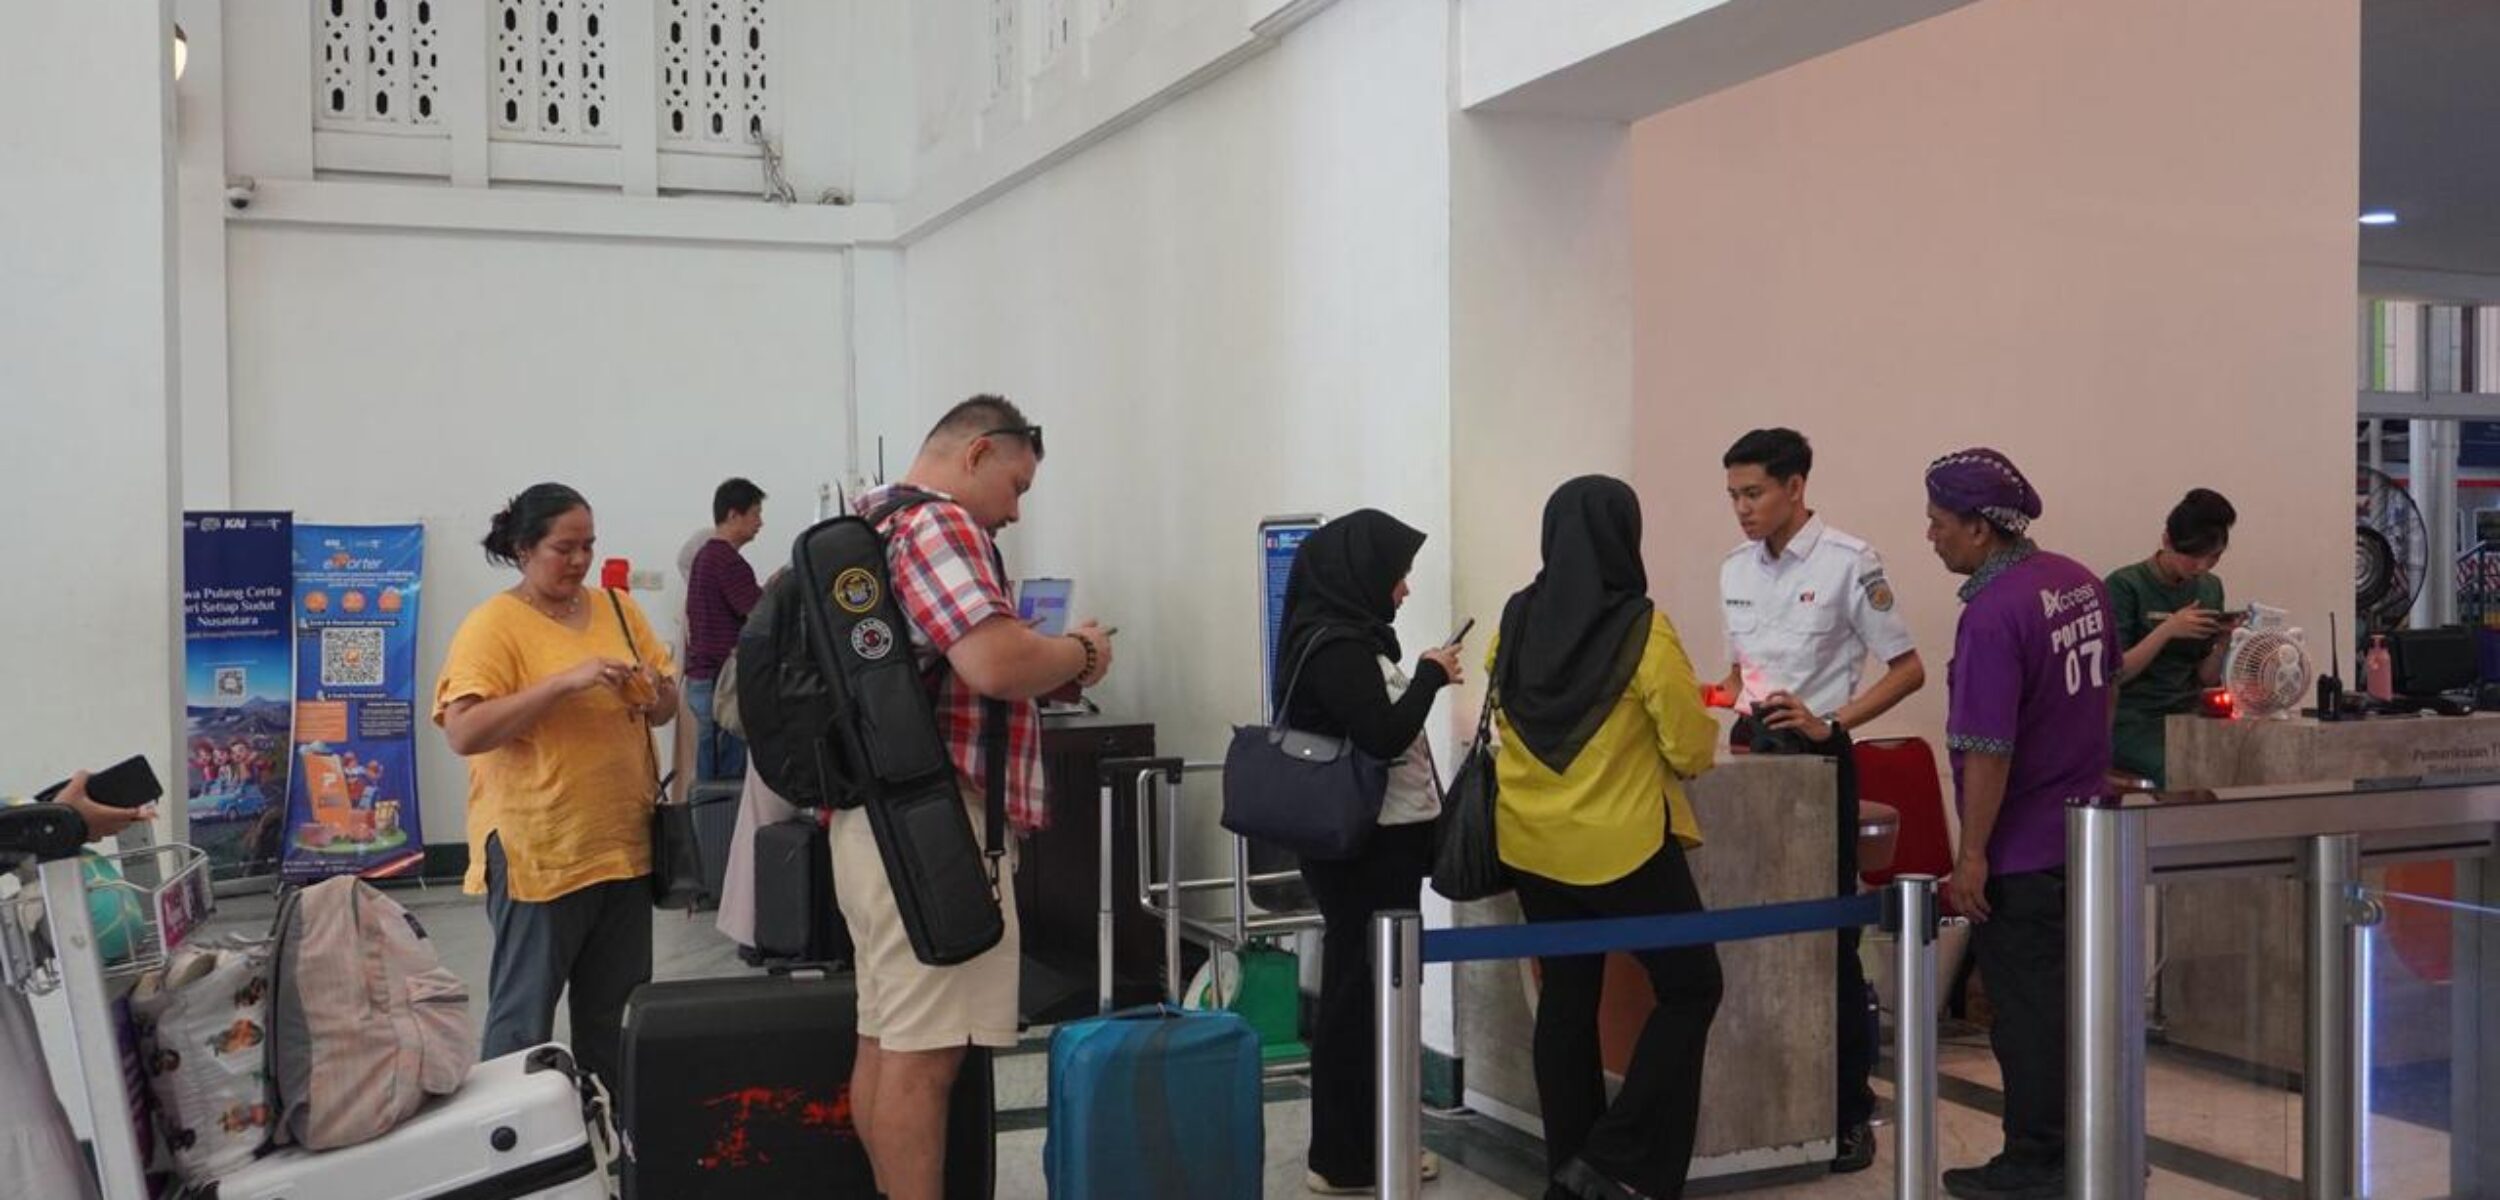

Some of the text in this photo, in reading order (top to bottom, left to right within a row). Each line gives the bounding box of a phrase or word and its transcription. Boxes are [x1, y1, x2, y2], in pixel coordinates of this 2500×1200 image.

[184, 586, 282, 601] wa Pulang Cerita
[185, 600, 276, 614] ari Setiap Sudut
[198, 616, 259, 626] Nusantara
[2051, 609, 2103, 654] PORTER
[2065, 638, 2103, 696] 07
